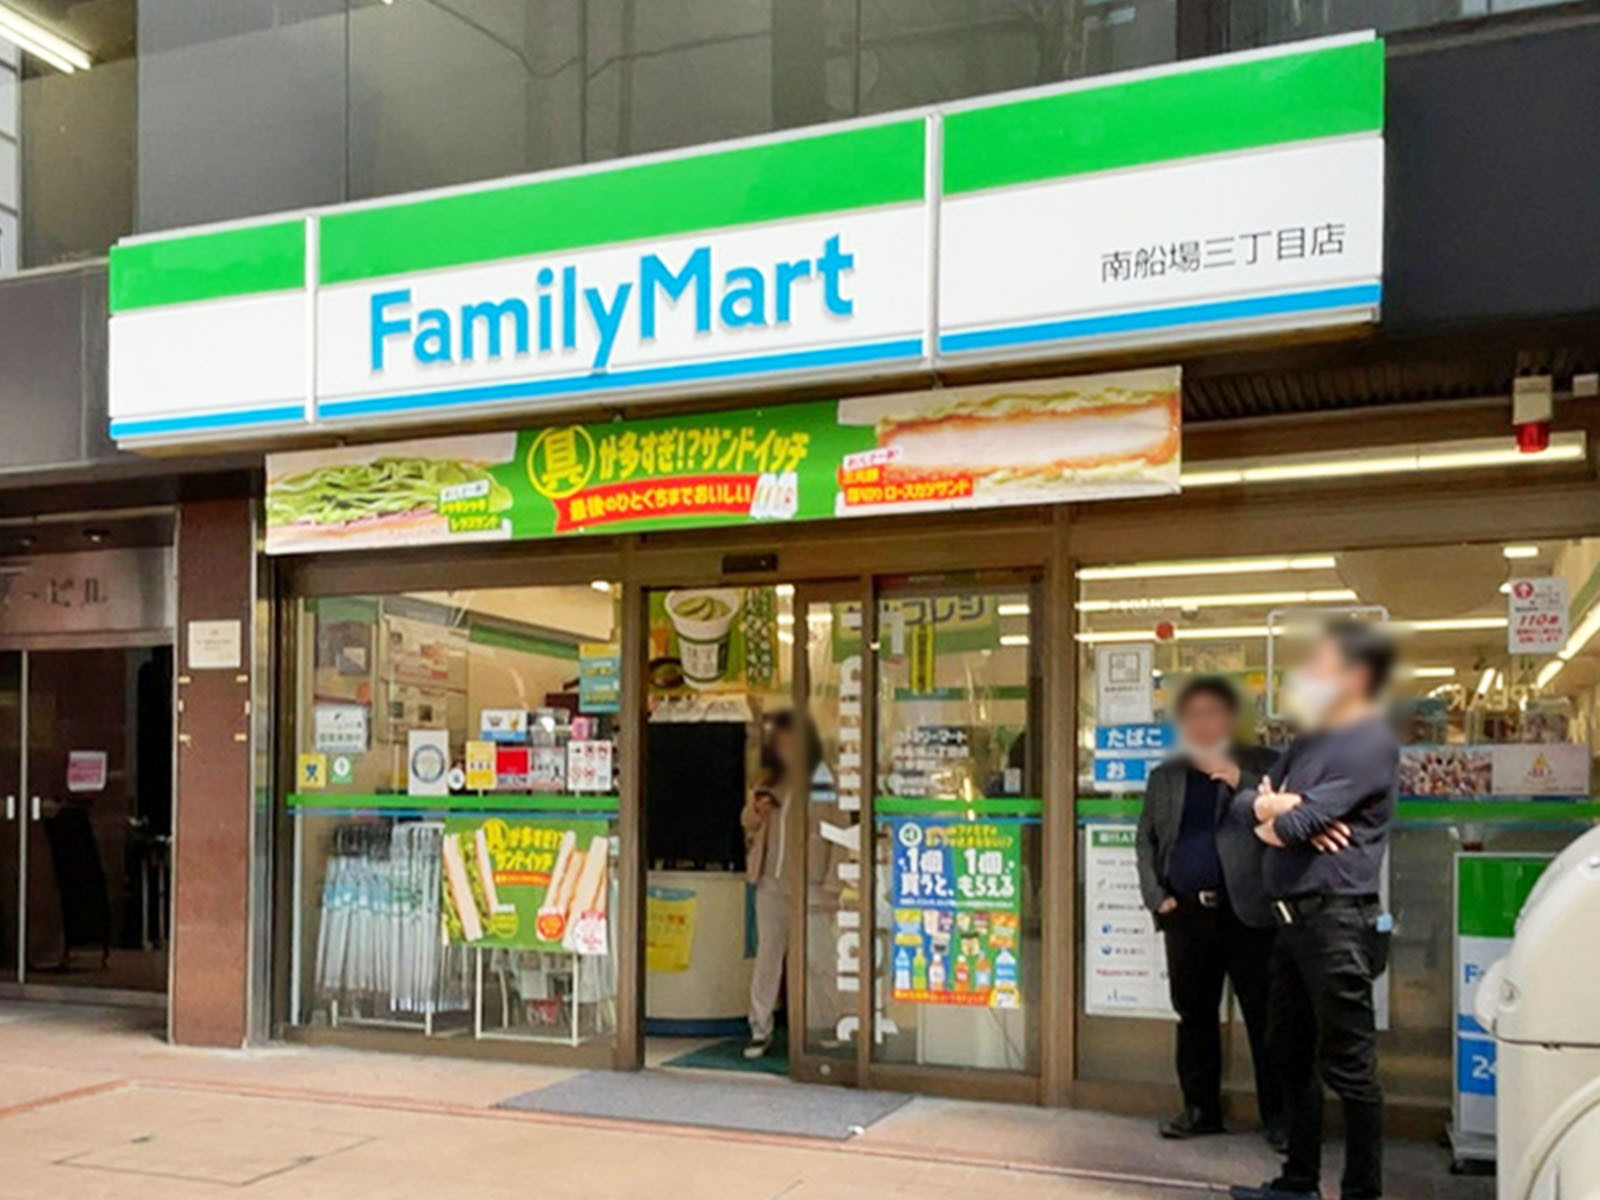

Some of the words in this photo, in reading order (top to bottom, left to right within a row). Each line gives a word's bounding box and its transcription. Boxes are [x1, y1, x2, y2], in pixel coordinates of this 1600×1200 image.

[1101, 223, 1346, 284] 南船場三丁目店
[370, 233, 854, 373] FamilyMart
[1107, 728, 1163, 749] たばこ
[957, 874, 1014, 898] もらえる
